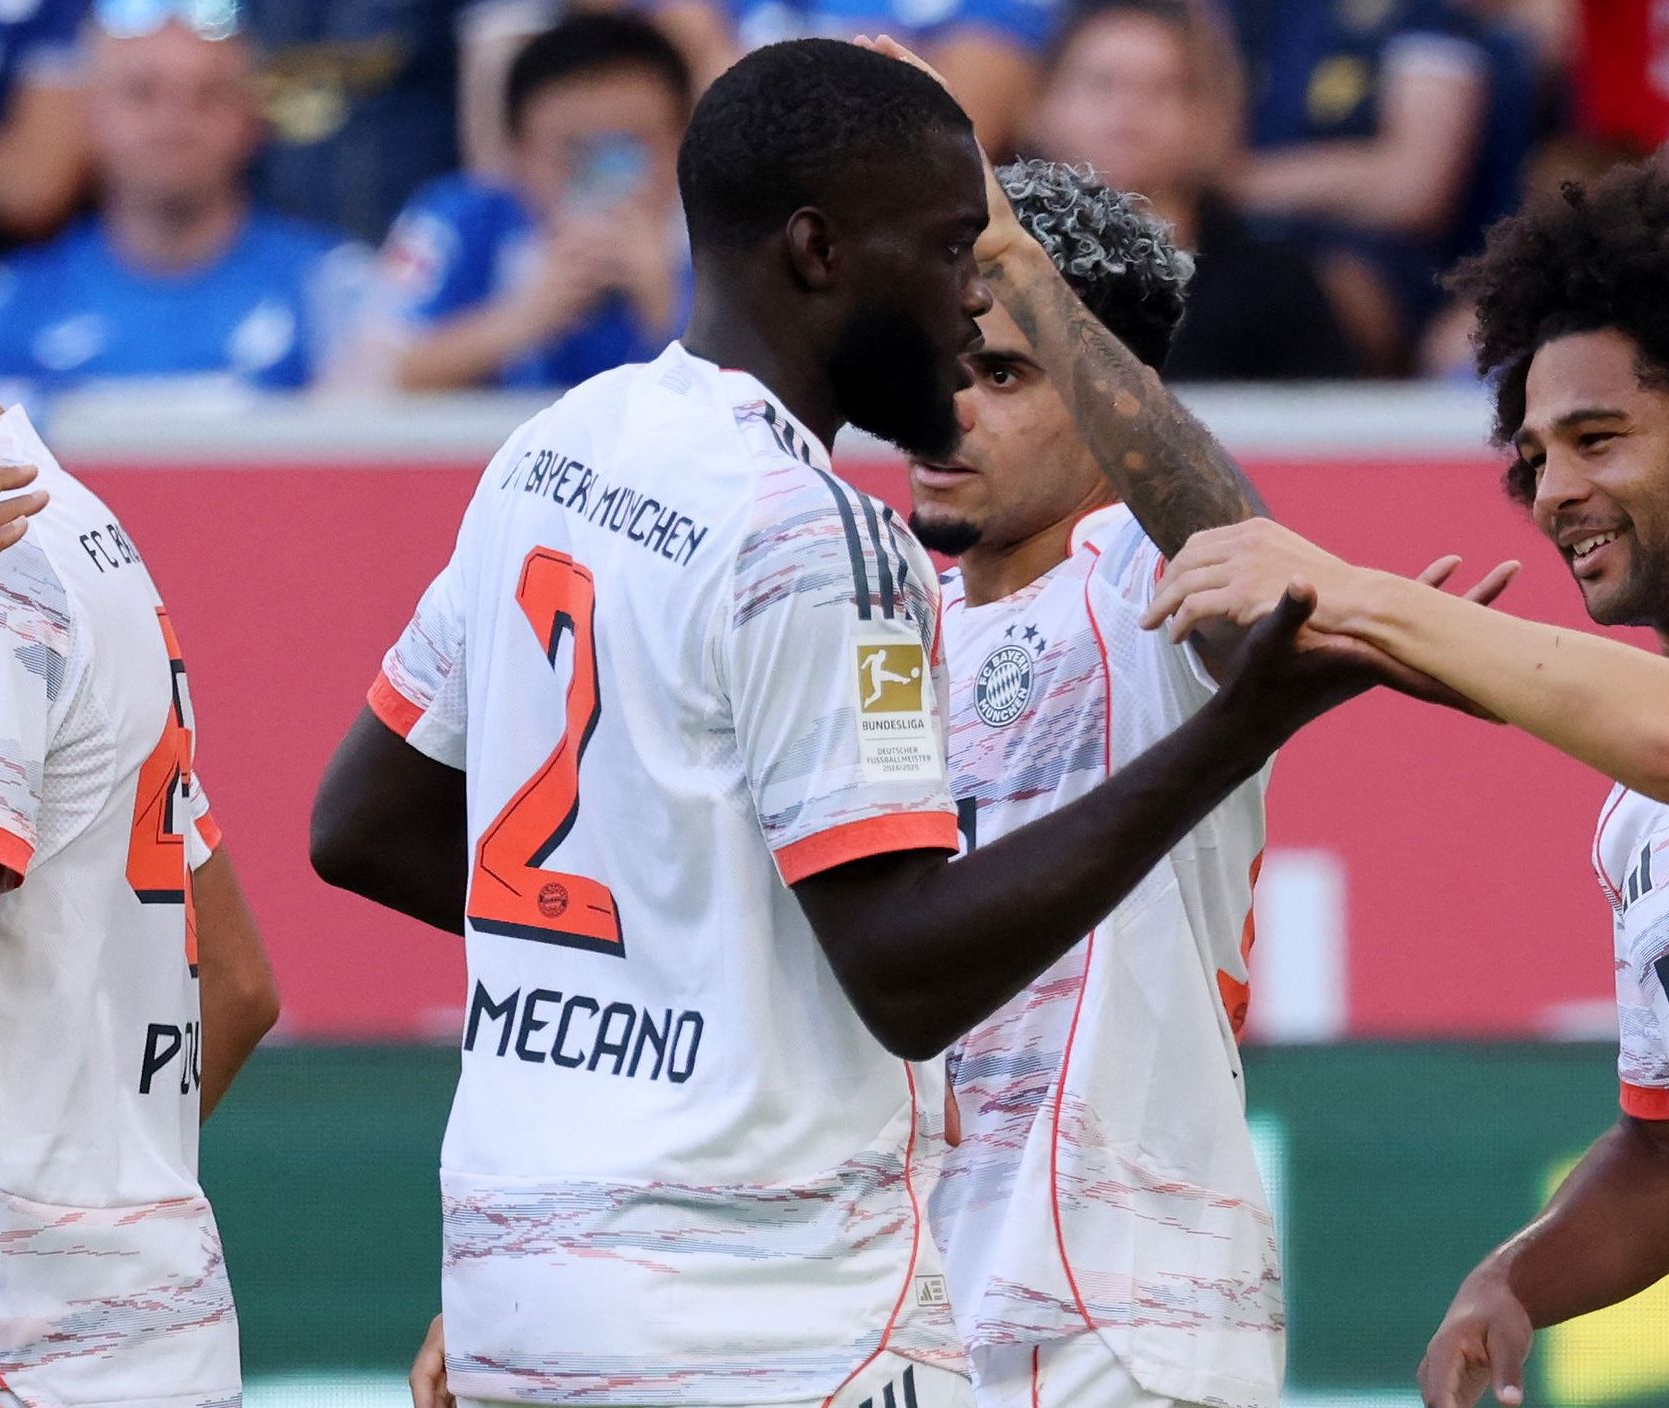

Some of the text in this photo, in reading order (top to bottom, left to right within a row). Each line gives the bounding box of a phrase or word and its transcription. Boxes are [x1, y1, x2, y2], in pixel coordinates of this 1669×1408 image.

[992, 650, 1030, 676] BAYERN
[862, 719, 925, 731] BUNDESLIGA
[465, 544, 626, 958] 2
[877, 746, 919, 756] DEUTSCHER
[463, 977, 705, 1084] MECANO
